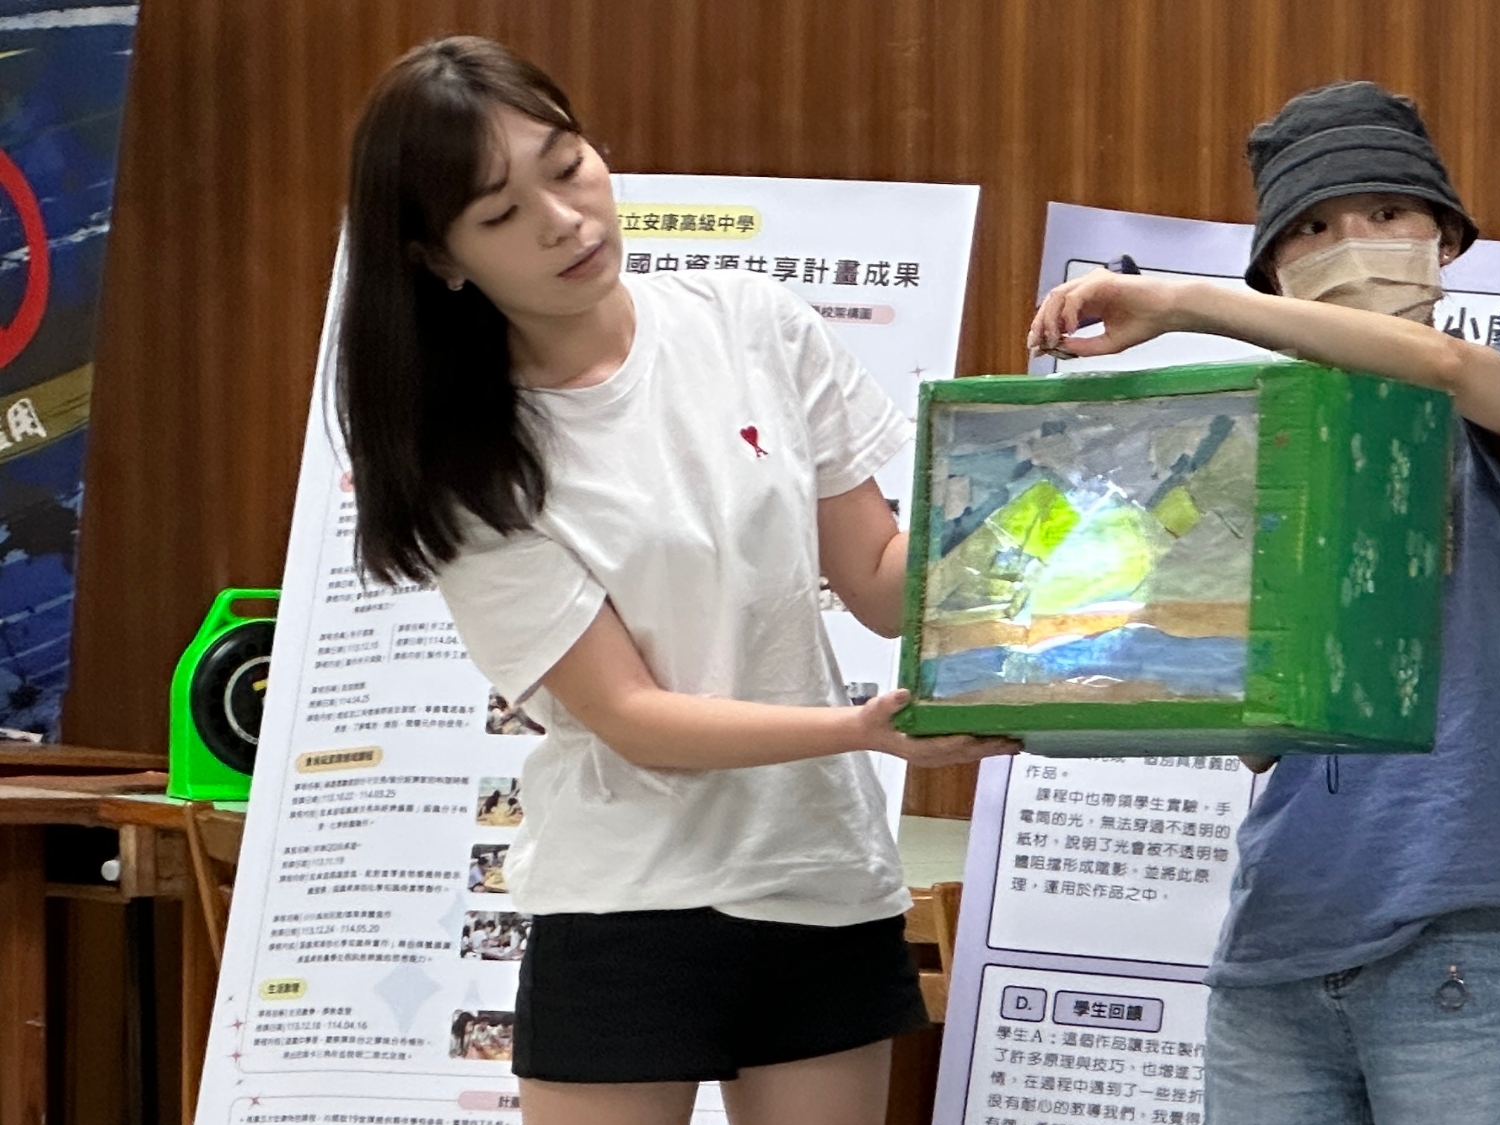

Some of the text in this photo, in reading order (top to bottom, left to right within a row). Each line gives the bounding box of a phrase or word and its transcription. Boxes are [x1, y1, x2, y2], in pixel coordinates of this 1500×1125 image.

[618, 213, 755, 233] 立安康高級中學
[1016, 996, 1032, 1011] D.
